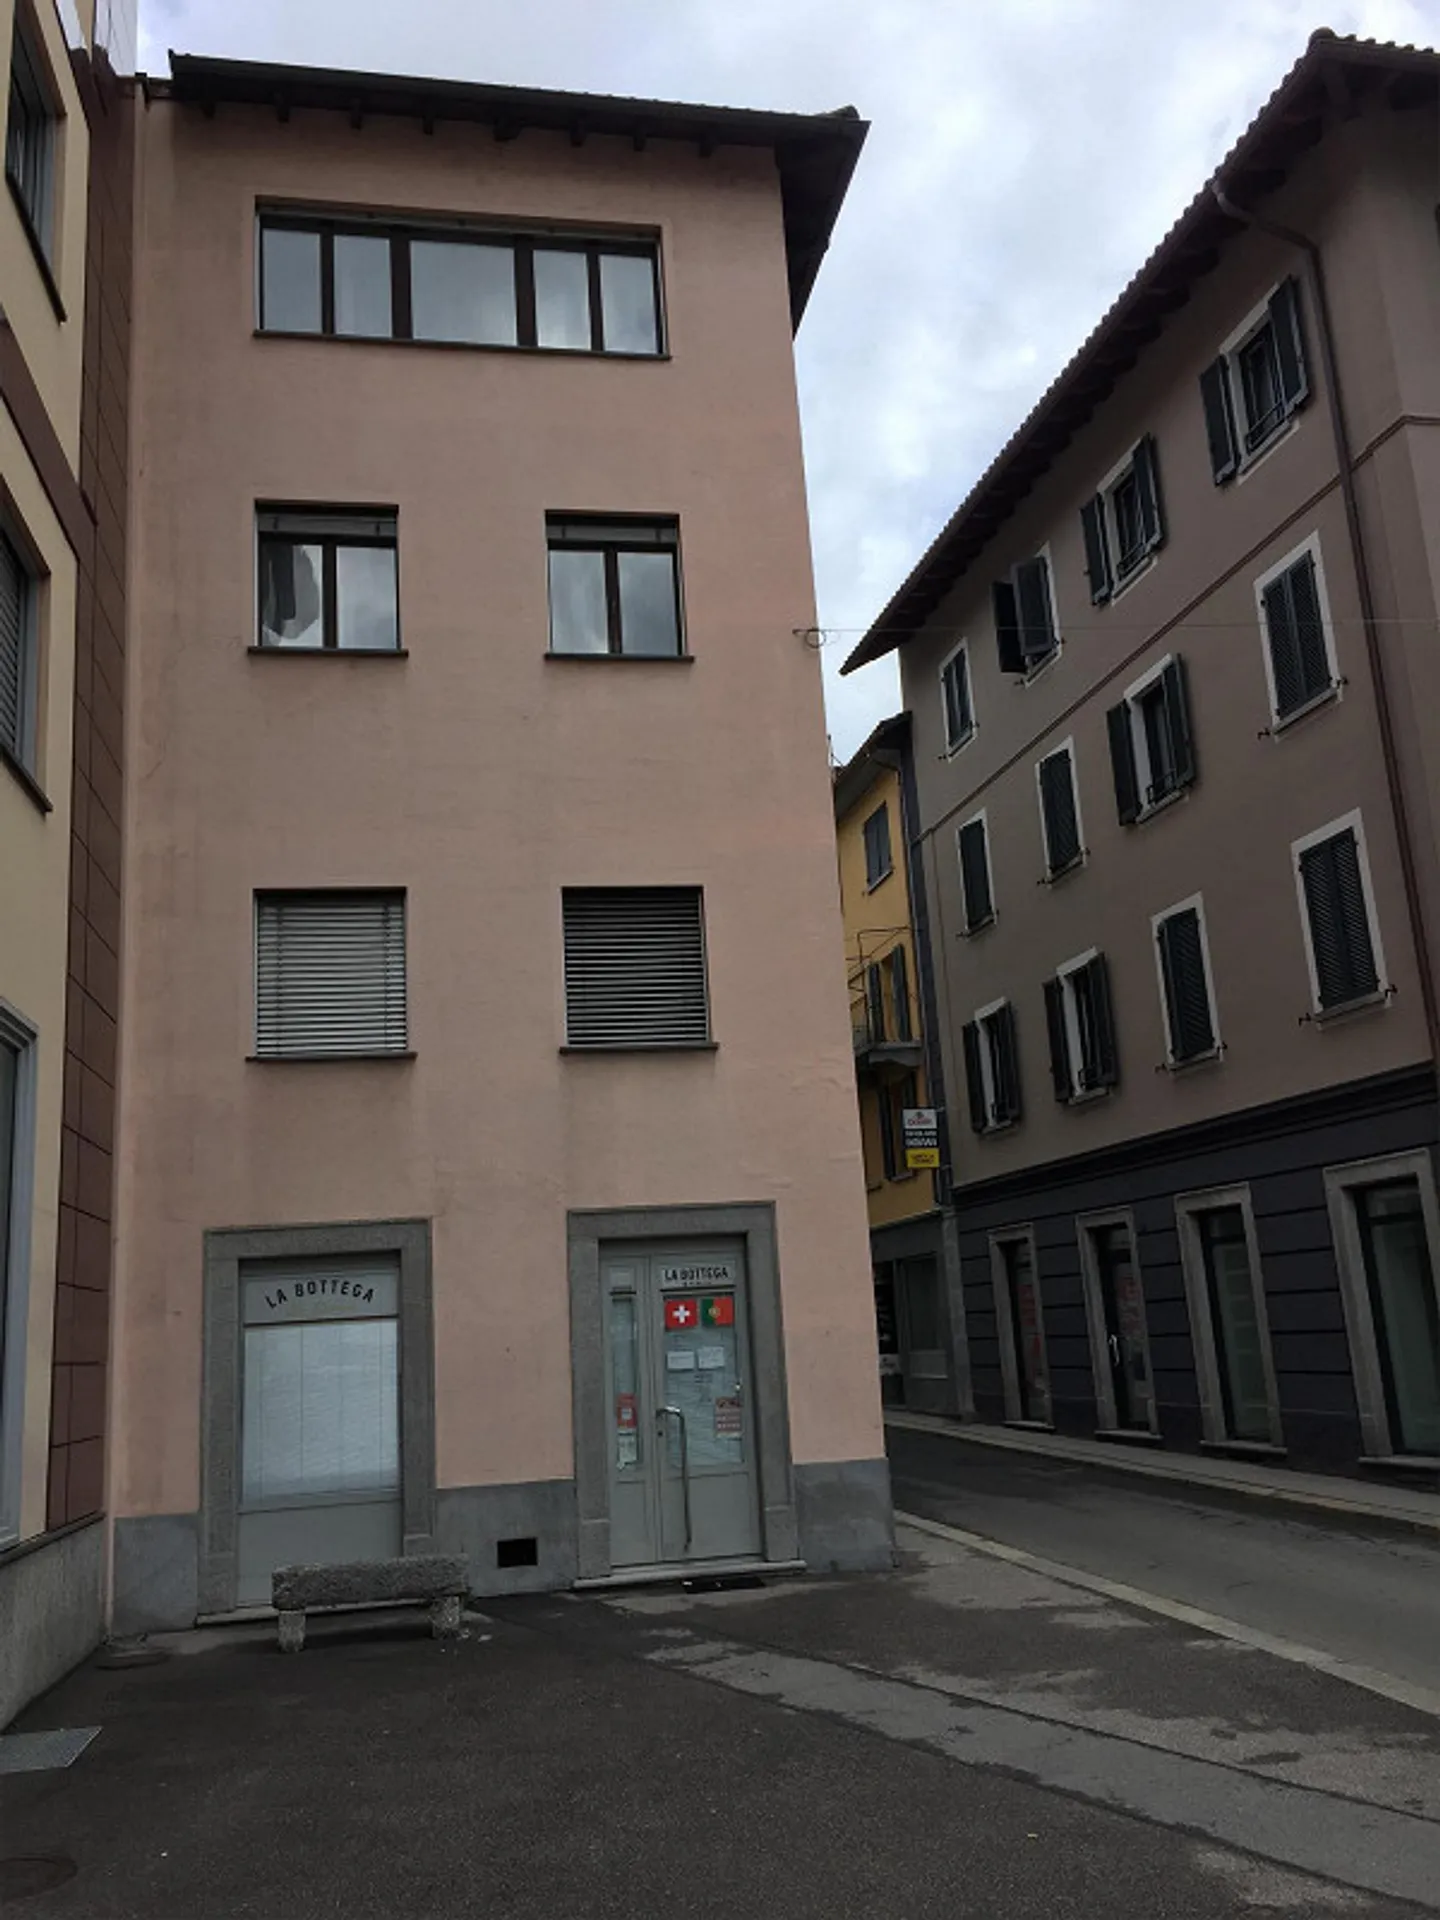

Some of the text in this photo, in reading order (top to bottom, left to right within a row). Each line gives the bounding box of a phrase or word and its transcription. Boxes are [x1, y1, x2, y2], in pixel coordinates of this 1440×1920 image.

[664, 1266, 729, 1281] LA BOTTEGA
[265, 1280, 375, 1309] LA BOTTEGA
